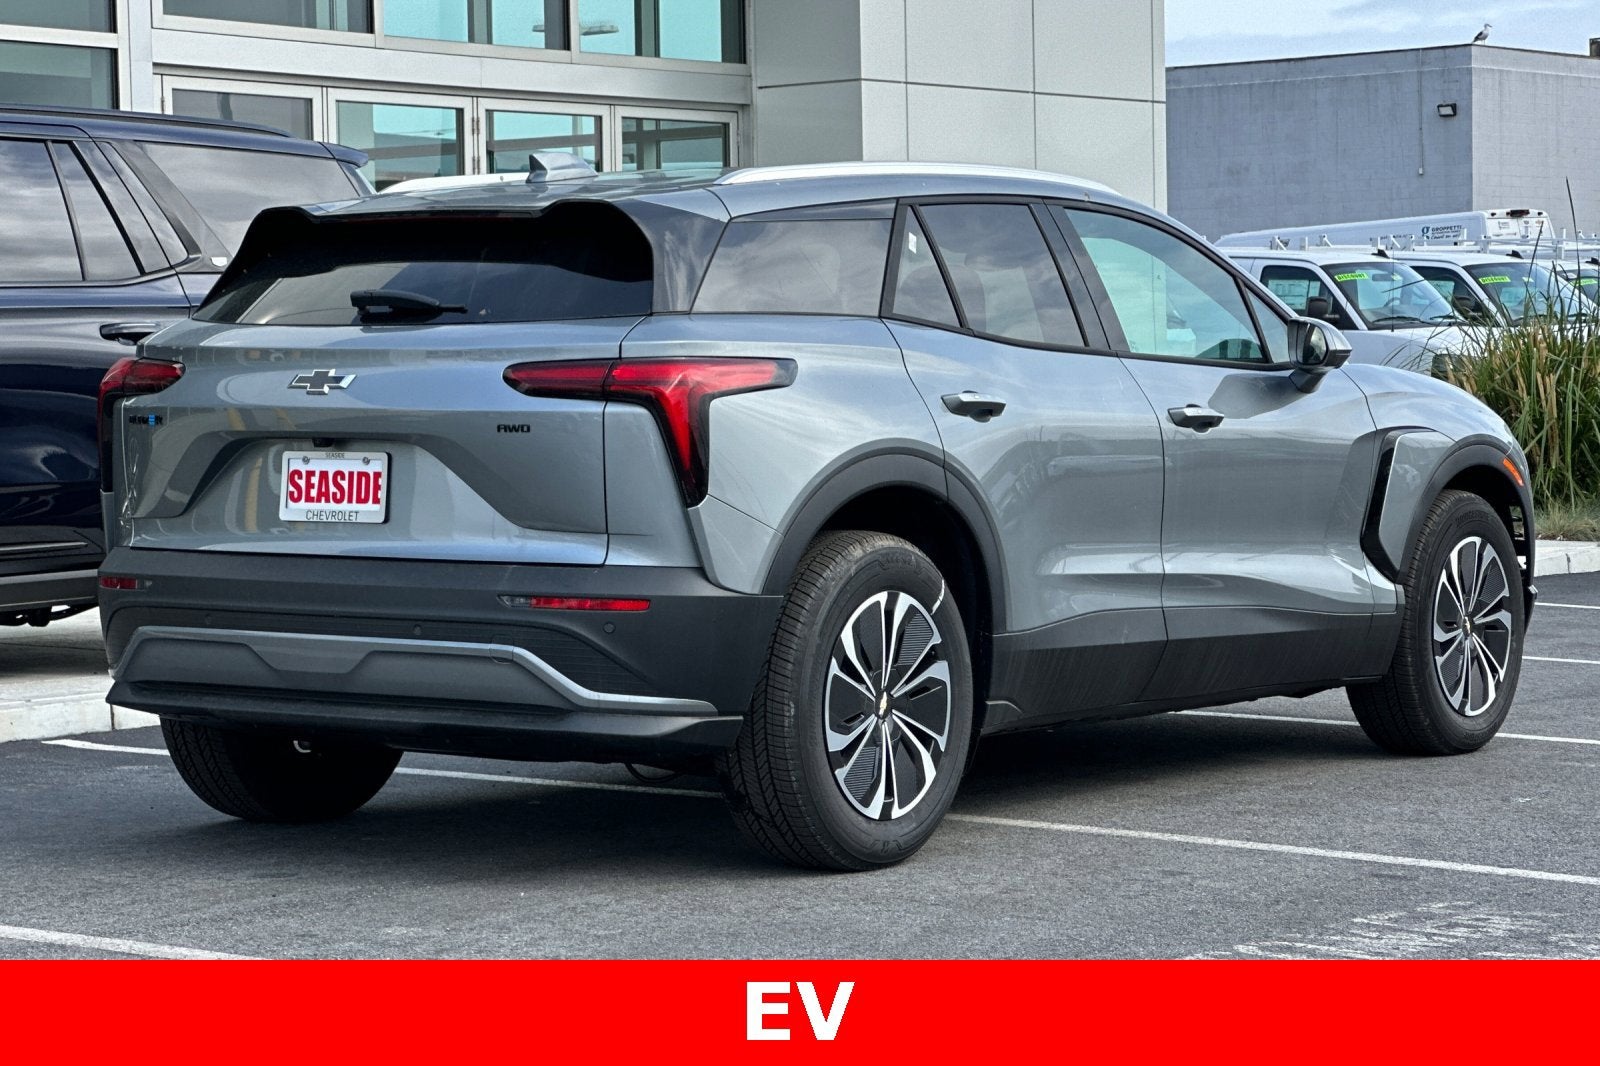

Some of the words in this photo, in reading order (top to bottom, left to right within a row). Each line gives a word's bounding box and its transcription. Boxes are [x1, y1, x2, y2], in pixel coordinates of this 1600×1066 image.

[497, 424, 530, 433] AWD
[288, 469, 382, 504] SEASIDE
[305, 510, 360, 521] CHEVROLET
